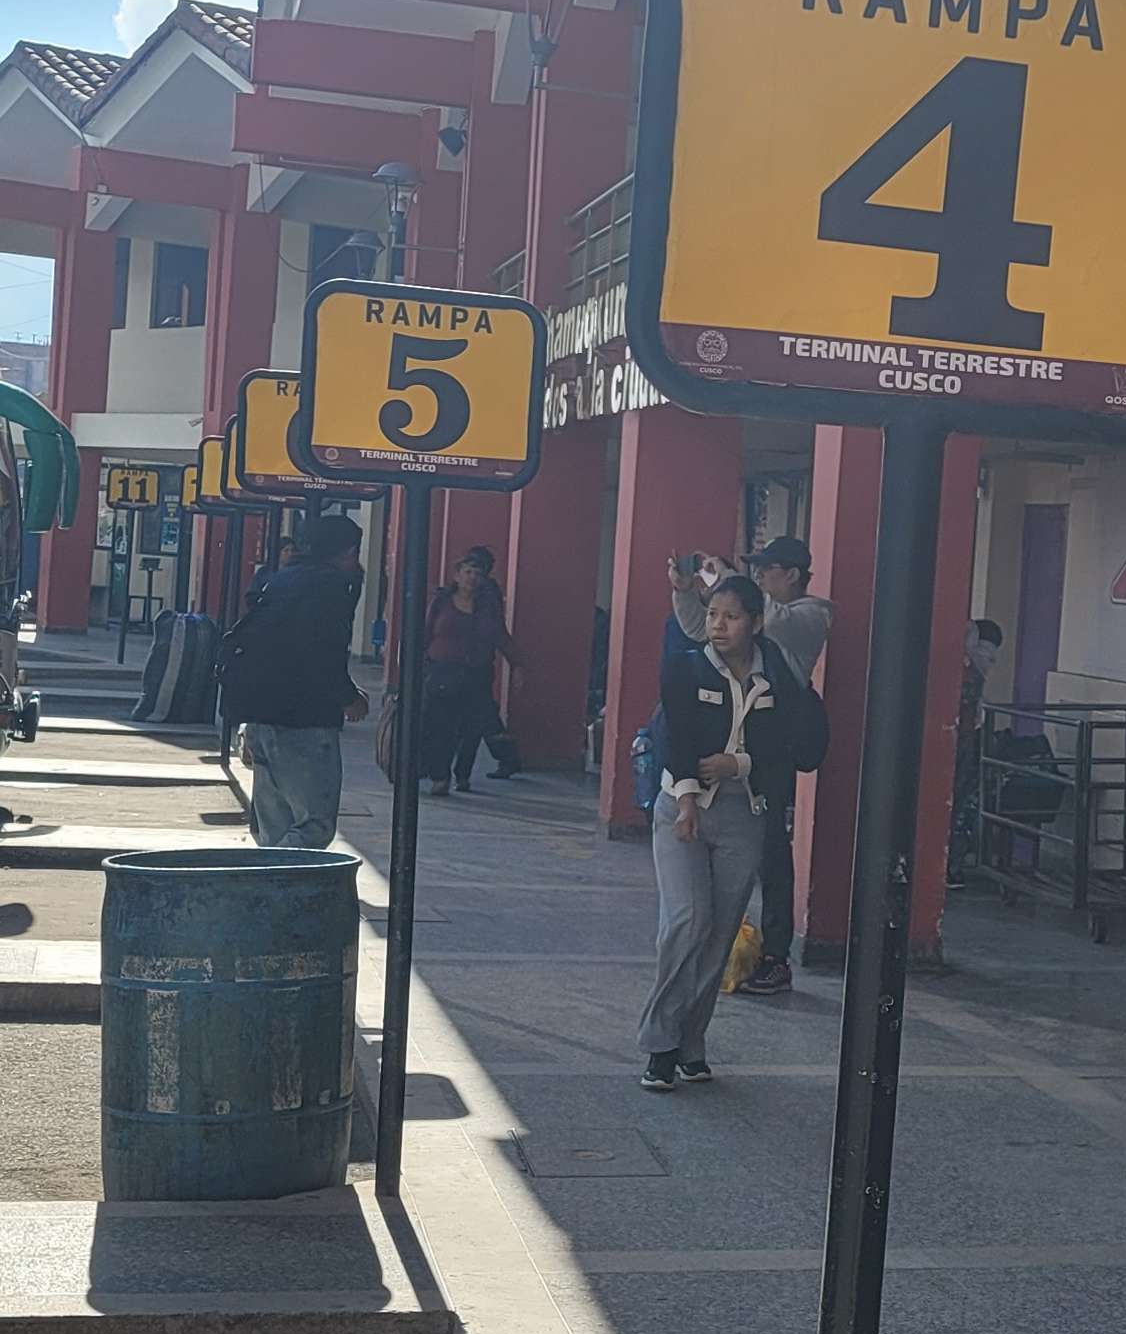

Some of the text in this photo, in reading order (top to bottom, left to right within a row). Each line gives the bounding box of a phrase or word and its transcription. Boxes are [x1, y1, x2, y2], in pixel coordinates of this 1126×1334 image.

[817, 56, 1053, 352] 4
[366, 299, 493, 334] RAMPA
[779, 336, 1064, 381] TERMINAL TERRESTRE
[379, 332, 471, 452] 5
[878, 369, 962, 395] CUSCO
[360, 450, 478, 467] TERMINAL TERRESTRE
[401, 462, 436, 473] CUSCO
[118, 477, 150, 503] 11
